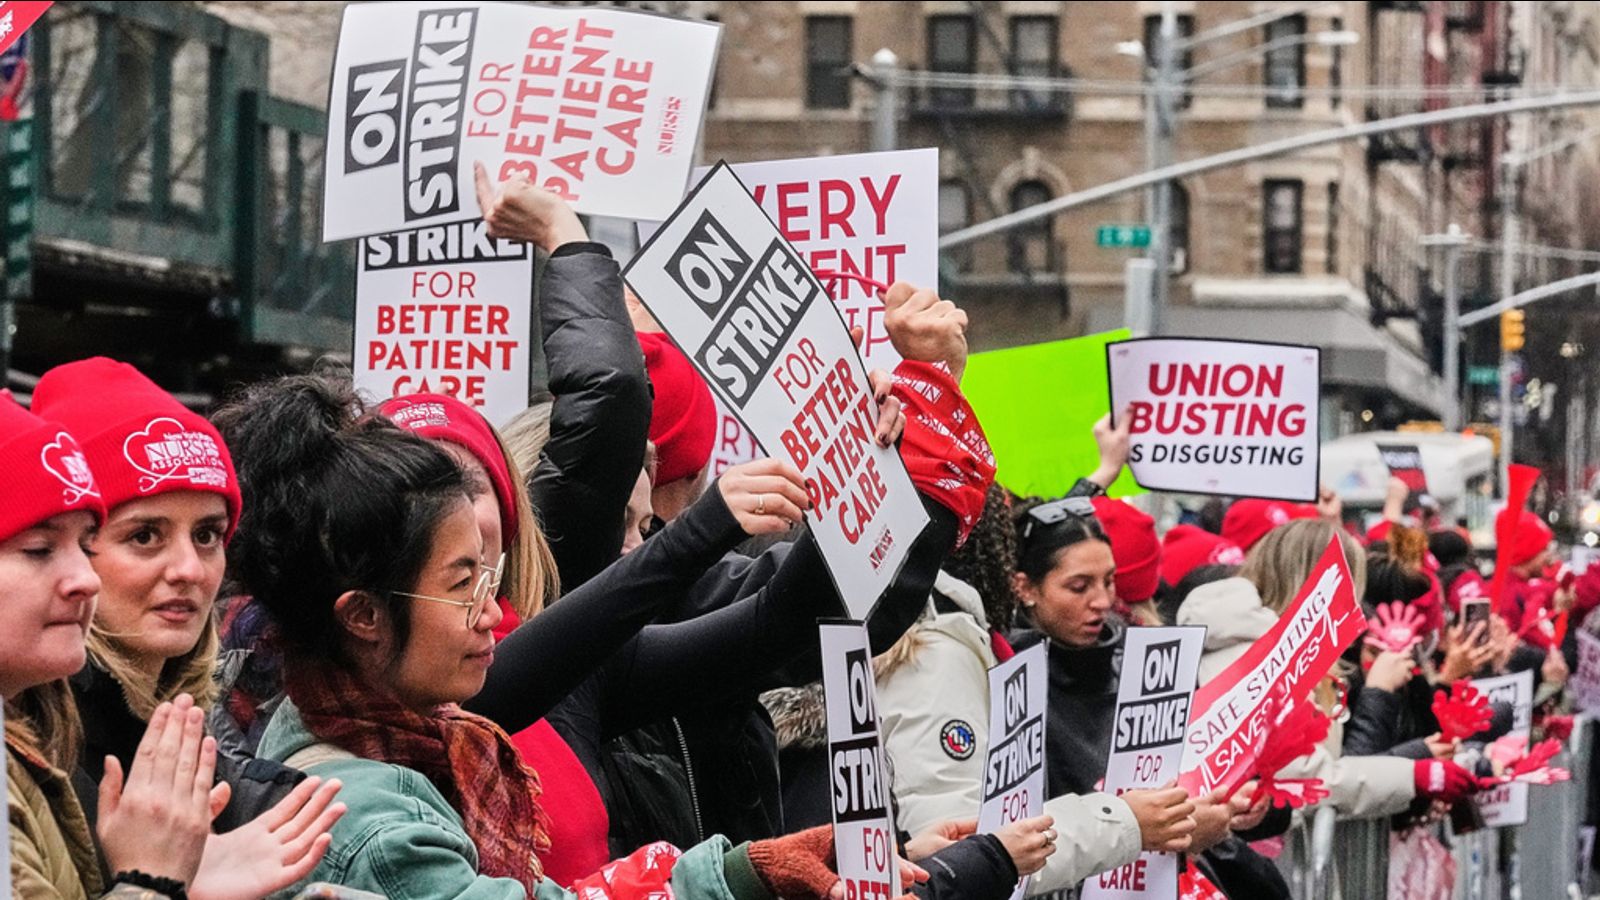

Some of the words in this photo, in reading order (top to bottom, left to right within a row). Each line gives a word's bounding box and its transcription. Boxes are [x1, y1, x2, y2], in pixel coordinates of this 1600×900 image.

[350, 67, 403, 166] ON
[408, 11, 475, 216] STRIKE
[466, 62, 515, 137] FOR
[497, 26, 568, 186] BETTER
[543, 18, 614, 202] PATIENT
[595, 58, 653, 175] CARE
[367, 221, 523, 267] STRIKE
[679, 222, 744, 303] ON
[799, 244, 906, 301] ENT
[412, 271, 477, 299] FOR
[377, 304, 510, 335] BETTER
[703, 247, 810, 402] STRIKE
[367, 340, 519, 371] PATIENT
[773, 337, 825, 404] FOR
[1148, 363, 1285, 398] UNION
[780, 358, 859, 473] BETTER
[1128, 402, 1306, 437] BUSTING
[144, 438, 220, 461] NURSES
[805, 393, 877, 522] PATIENT
[1130, 443, 1144, 463] S
[1151, 444, 1304, 466] DISGUSTING
[838, 455, 888, 545] CARE
[1005, 671, 1027, 728] ON
[1144, 646, 1178, 690] ON
[1189, 695, 1243, 755] SAFE
[1247, 591, 1326, 701] STAFFING
[1116, 696, 1188, 750] STRIKE
[833, 746, 887, 814] STRI
[985, 725, 1042, 797] STRIKE
[1135, 755, 1162, 783] FOR
[1001, 790, 1029, 826] FOR
